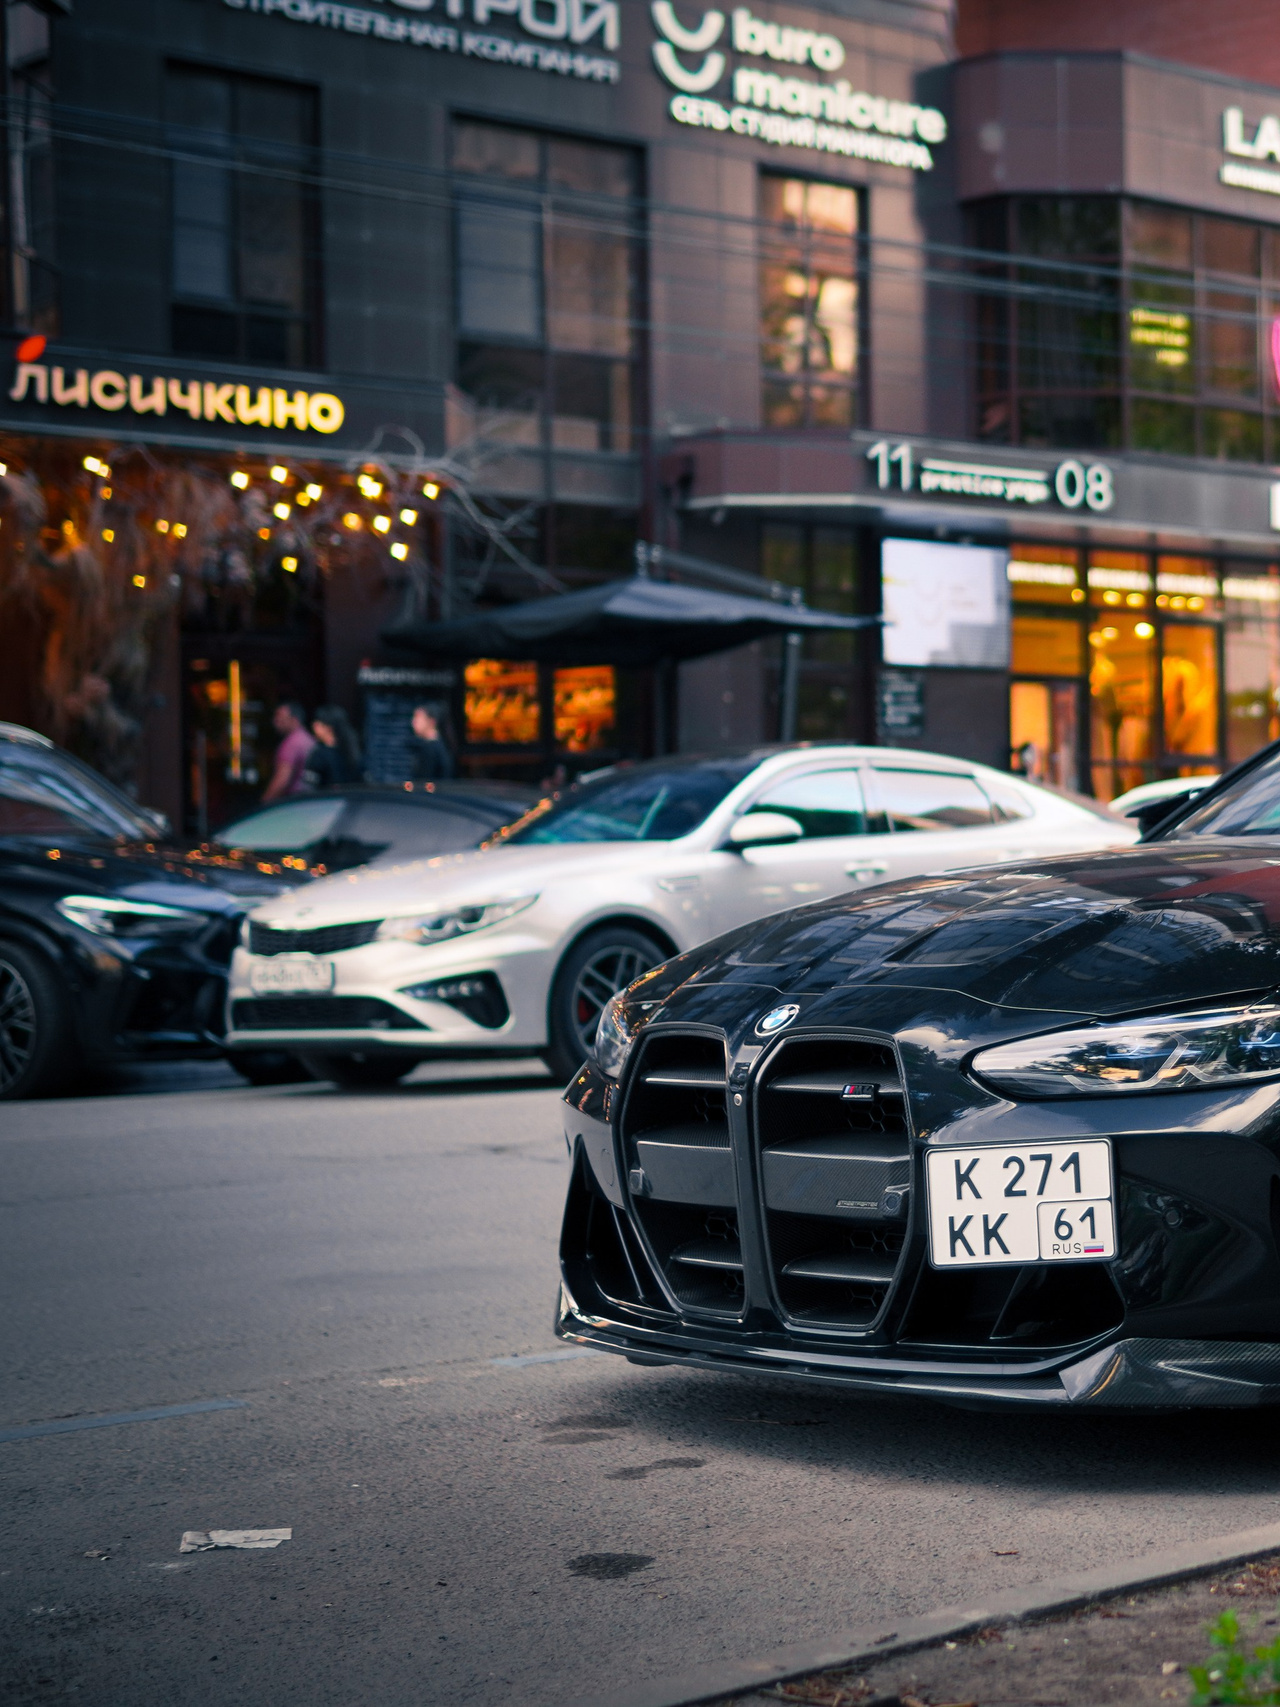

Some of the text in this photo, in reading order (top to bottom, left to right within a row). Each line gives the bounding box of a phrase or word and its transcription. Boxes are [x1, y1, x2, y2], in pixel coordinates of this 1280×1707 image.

[461, 31, 620, 84] КОМПАНИЯ
[731, 7, 845, 71] buro
[670, 94, 730, 131] СЕТЬ
[732, 66, 947, 144] manicure
[10, 363, 345, 434] лисичкино
[866, 440, 1115, 511] 11 08
[954, 1151, 1082, 1201] К 271
[948, 1206, 1097, 1258] КК 61
[1052, 1242, 1083, 1255] RUS
